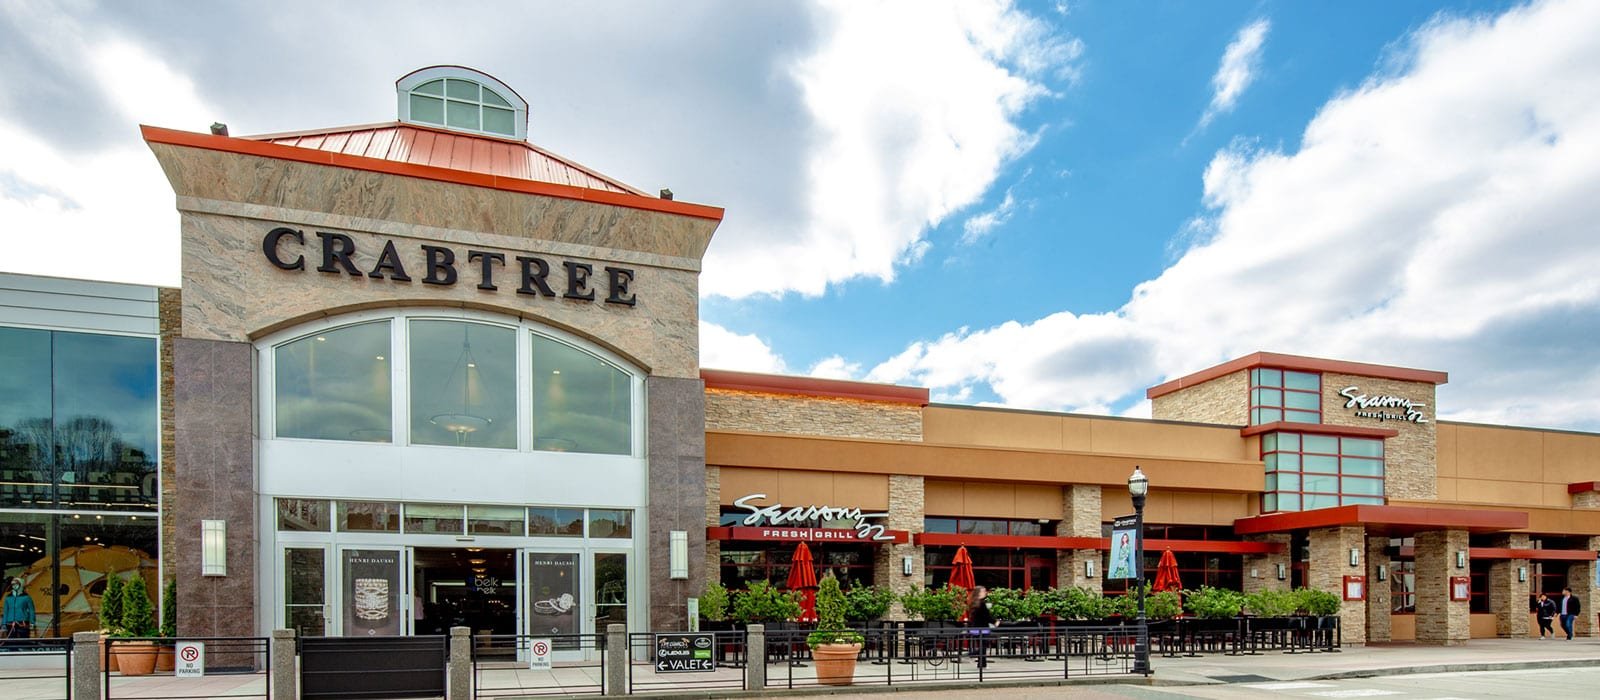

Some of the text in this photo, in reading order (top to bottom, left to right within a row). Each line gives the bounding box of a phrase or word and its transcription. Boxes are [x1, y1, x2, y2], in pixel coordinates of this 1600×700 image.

[262, 227, 637, 307] CRABTREE
[1340, 386, 1426, 408] Seasons
[734, 494, 889, 525] Seasons
[763, 530, 808, 538] FRESH
[855, 517, 895, 540] 52
[475, 577, 499, 586] belk
[669, 659, 701, 670] VALET
